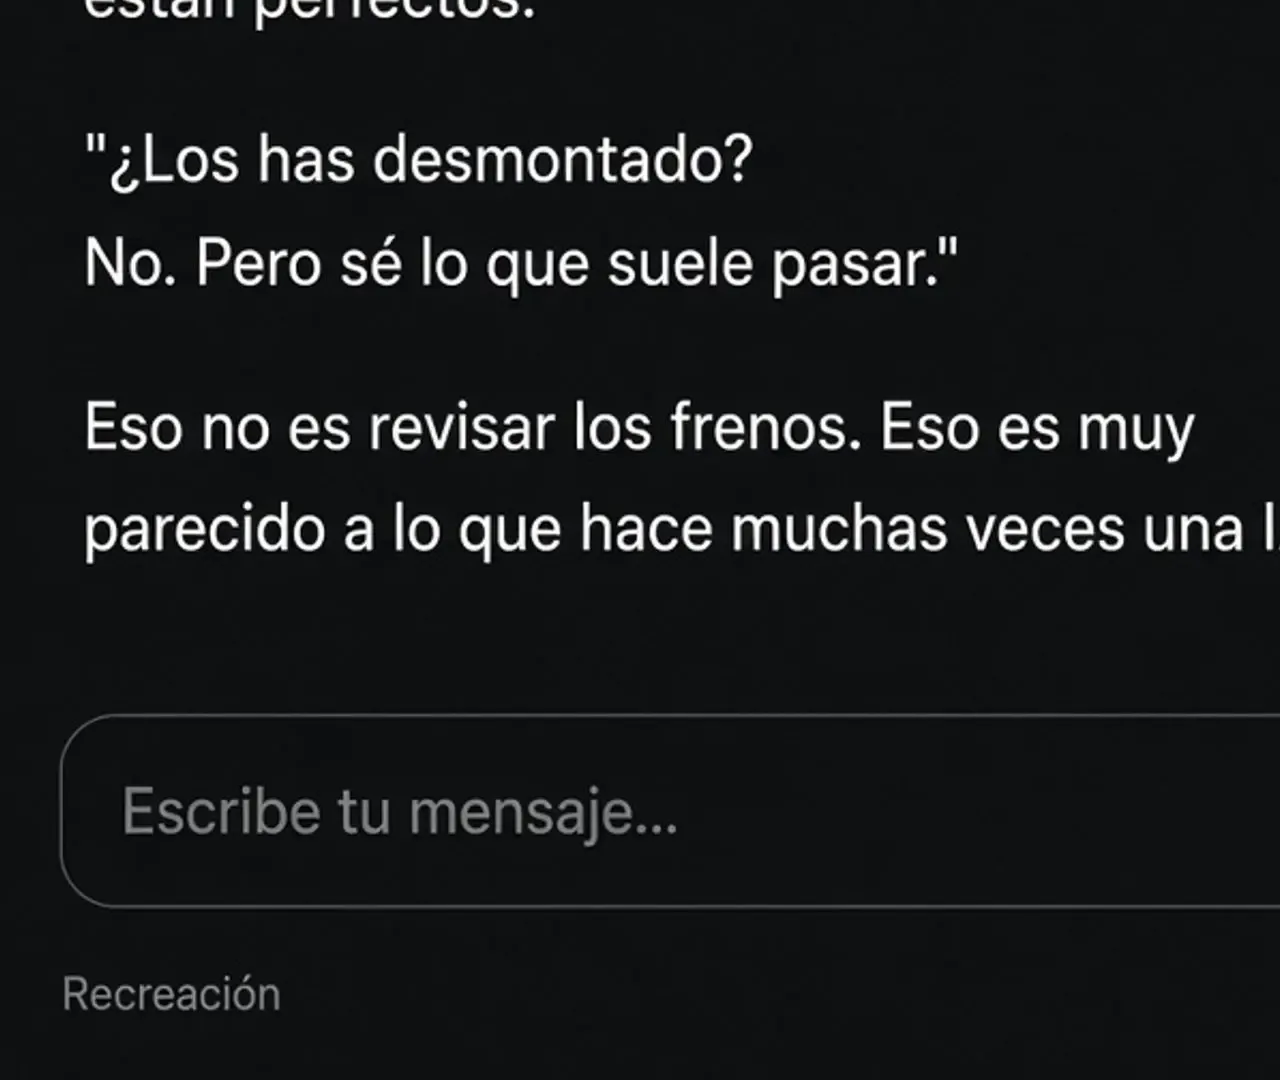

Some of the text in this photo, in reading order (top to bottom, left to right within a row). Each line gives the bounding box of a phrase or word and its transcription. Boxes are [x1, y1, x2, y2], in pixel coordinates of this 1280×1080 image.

[86, 131, 753, 195] "¿Los has desmontado?
[87, 234, 958, 300] No. Pero sé lo que suele pasar."
[87, 399, 1196, 464] Eso no es revisar los frenos. Eso es muy
[85, 500, 326, 565] parecido
[344, 514, 374, 552] a
[395, 500, 441, 552] lo
[459, 514, 561, 565] que
[582, 500, 713, 552] hace
[733, 500, 948, 552] muchas
[965, 514, 1125, 552] veces
[1145, 514, 1243, 552] una
[124, 784, 677, 848] Escribe tu mensaje...
